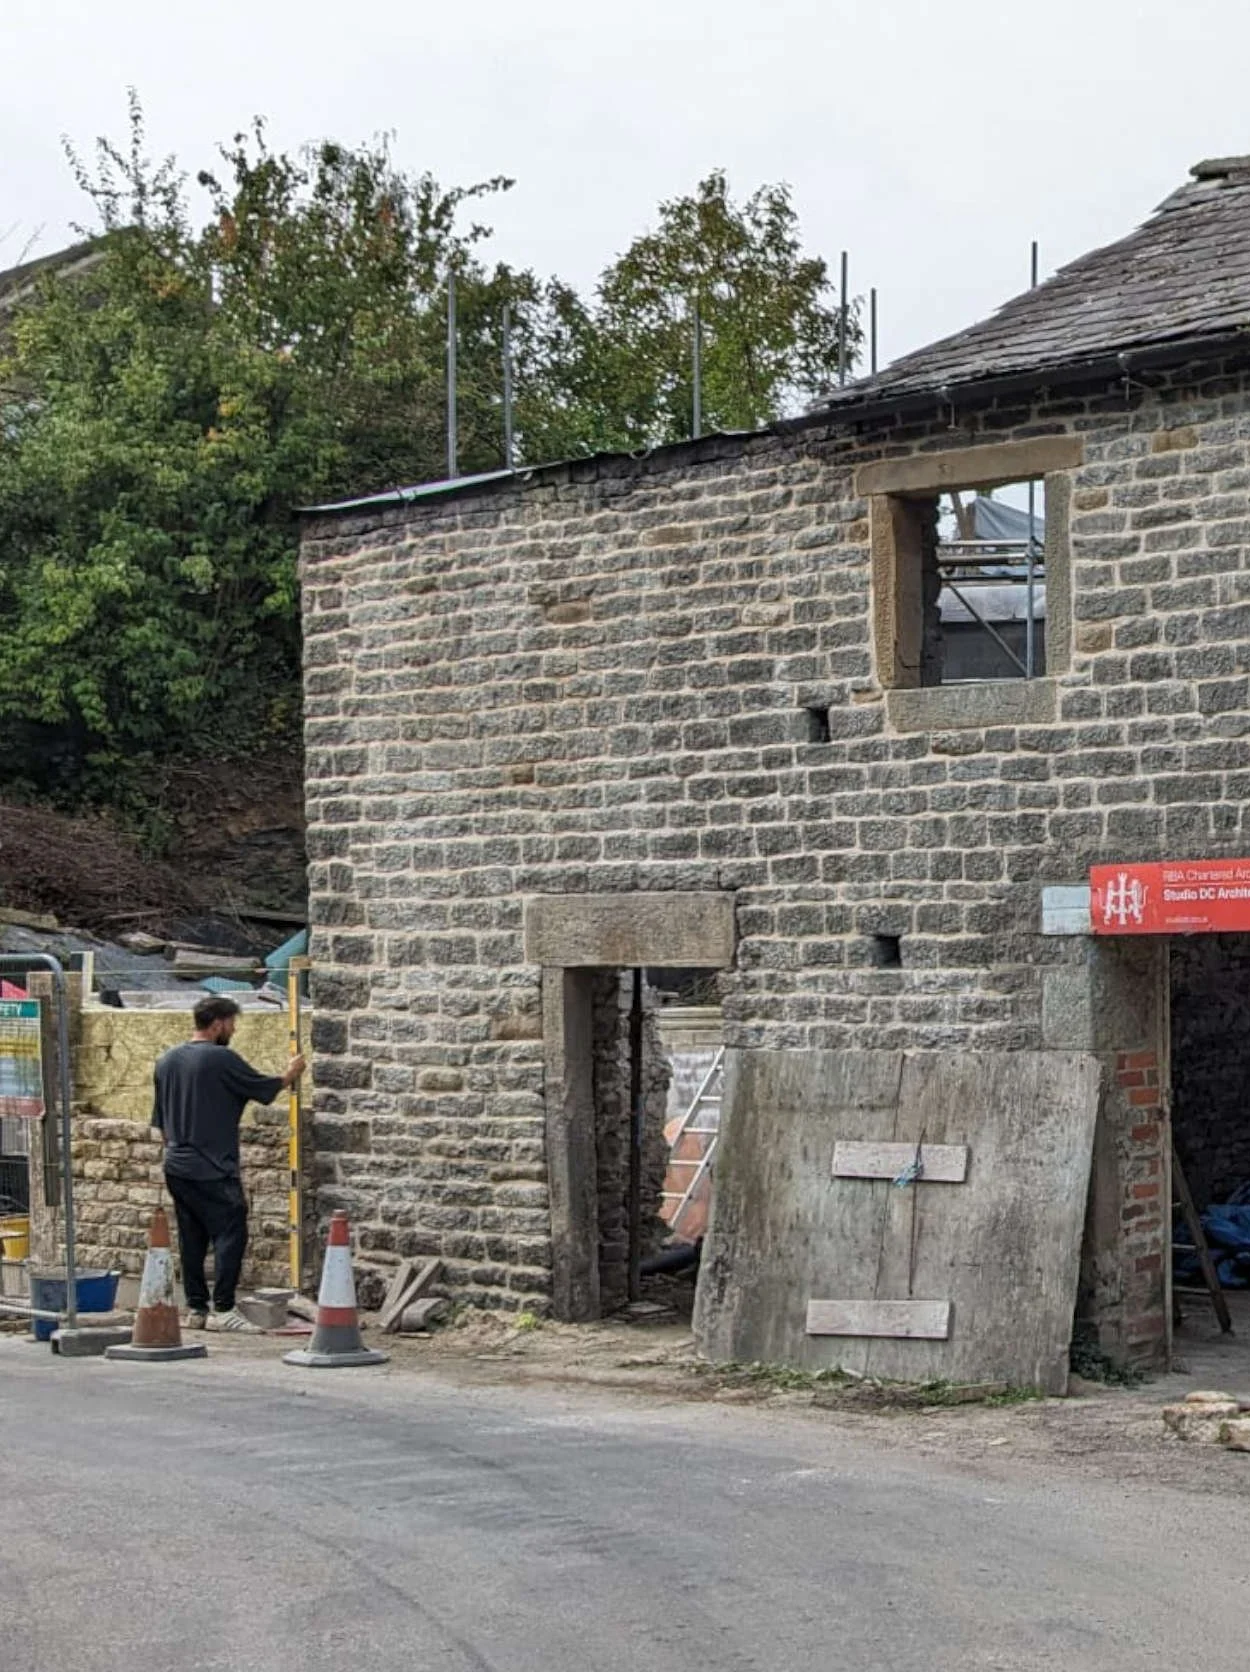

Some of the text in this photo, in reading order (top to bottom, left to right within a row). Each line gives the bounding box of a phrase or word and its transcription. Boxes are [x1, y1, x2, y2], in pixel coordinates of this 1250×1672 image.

[1186, 868, 1233, 881] Chartered
[1163, 888, 1197, 901] Studio
[1199, 887, 1216, 900] DC
